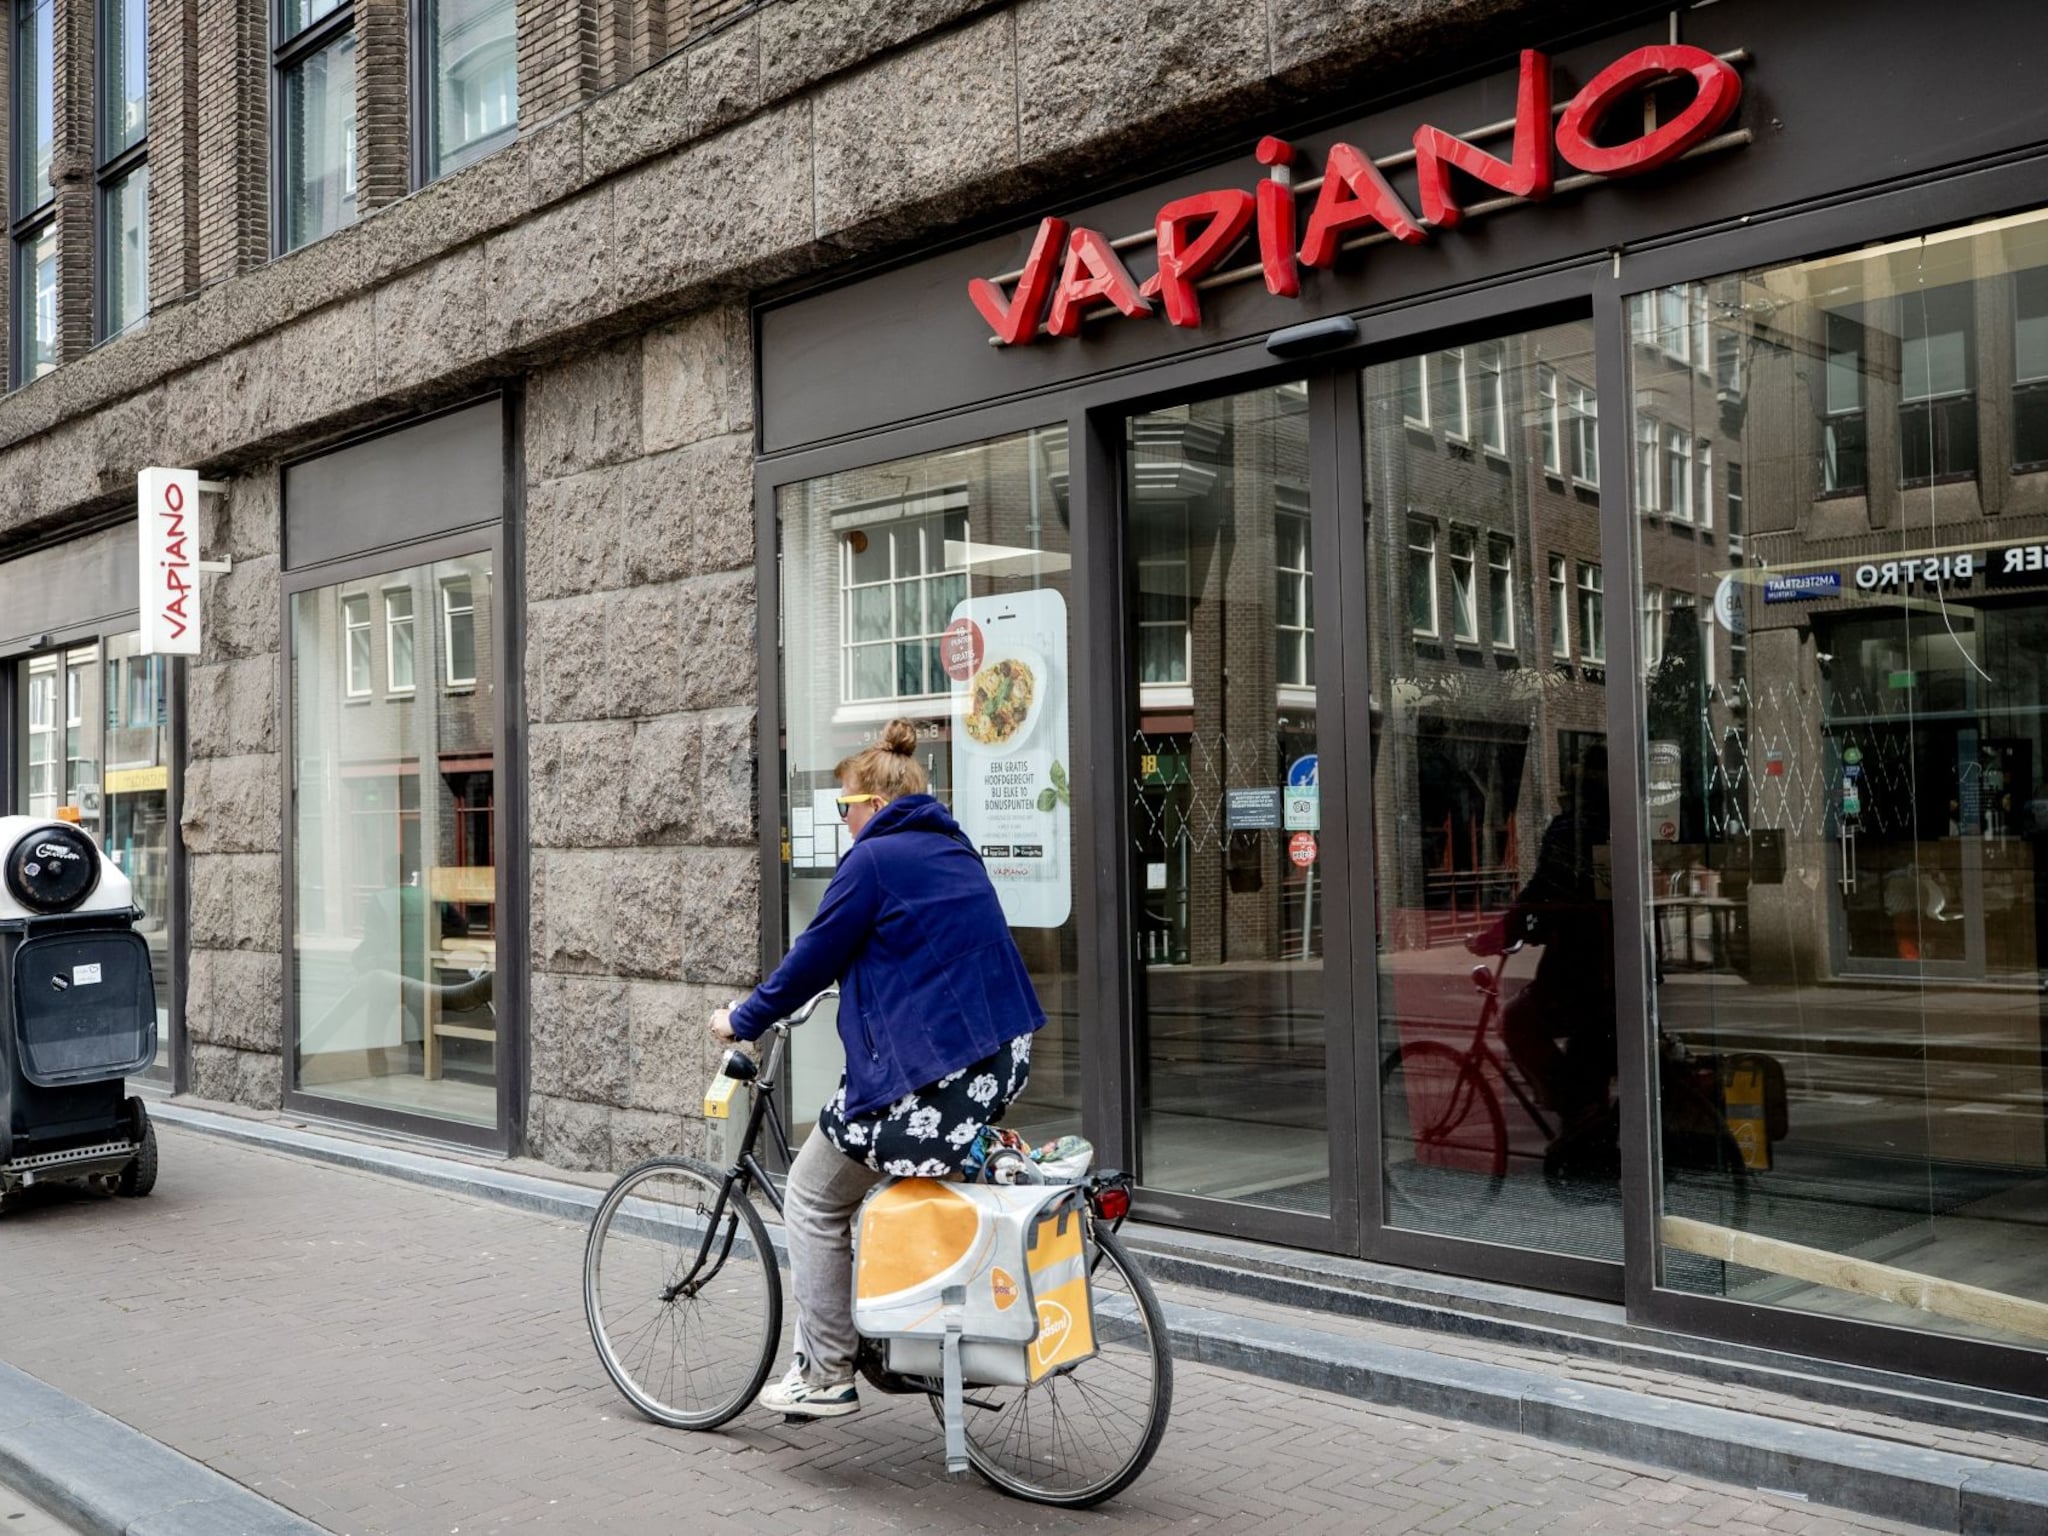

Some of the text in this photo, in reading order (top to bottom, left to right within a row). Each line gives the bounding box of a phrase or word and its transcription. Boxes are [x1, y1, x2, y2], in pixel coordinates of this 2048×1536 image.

[990, 760, 1028, 773] EEN GRATIS
[984, 773, 1034, 785] HOOFDGERECHT
[991, 786, 1002, 798] BIJ
[1003, 786, 1019, 798] ELKE
[984, 798, 1034, 810] BONUSPUNTEN
